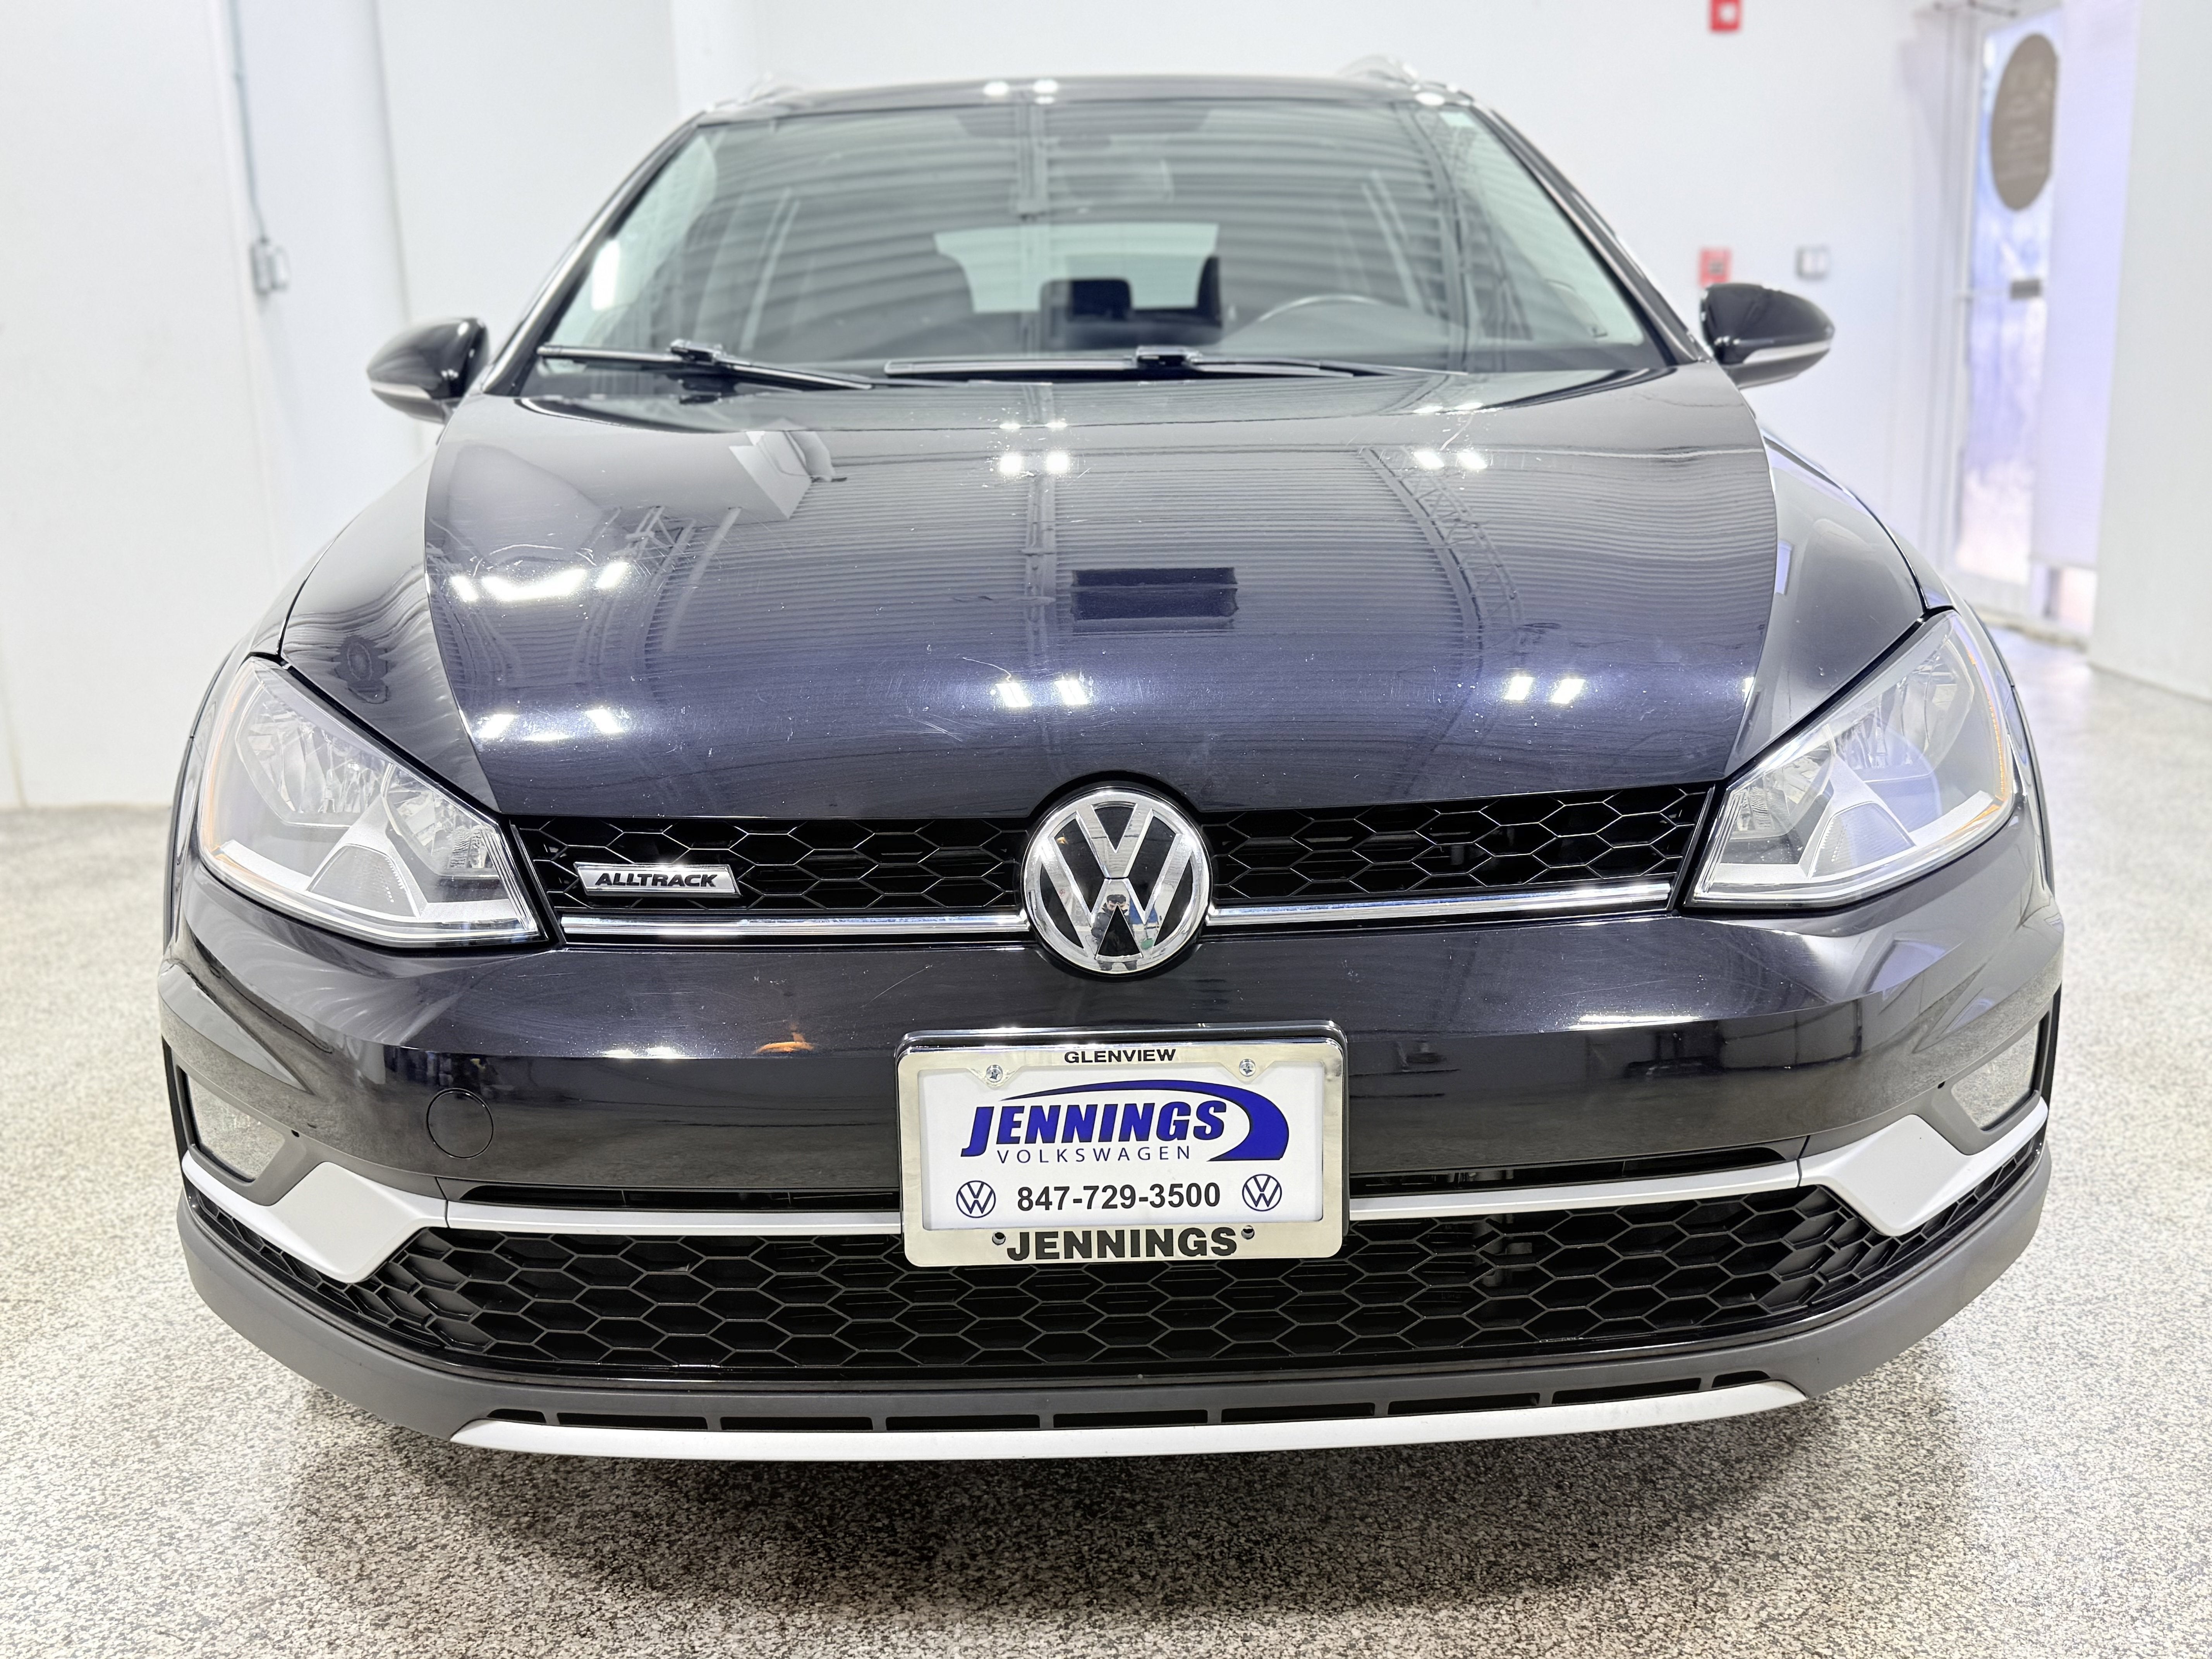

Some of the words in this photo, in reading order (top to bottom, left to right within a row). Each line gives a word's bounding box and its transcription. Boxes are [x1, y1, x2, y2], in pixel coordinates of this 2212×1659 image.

[594, 872, 718, 888] ALLTRACK
[1025, 787, 1209, 974] VW
[1064, 1048, 1176, 1064] GLENVIEW
[960, 1100, 1227, 1158] JENNINGS
[996, 1145, 1190, 1164] VOLKSWAGEN
[956, 1180, 996, 1219] VW
[1017, 1182, 1221, 1212] 847-729-3500
[1242, 1173, 1282, 1212] VW
[1006, 1226, 1237, 1261] JENNINGS
